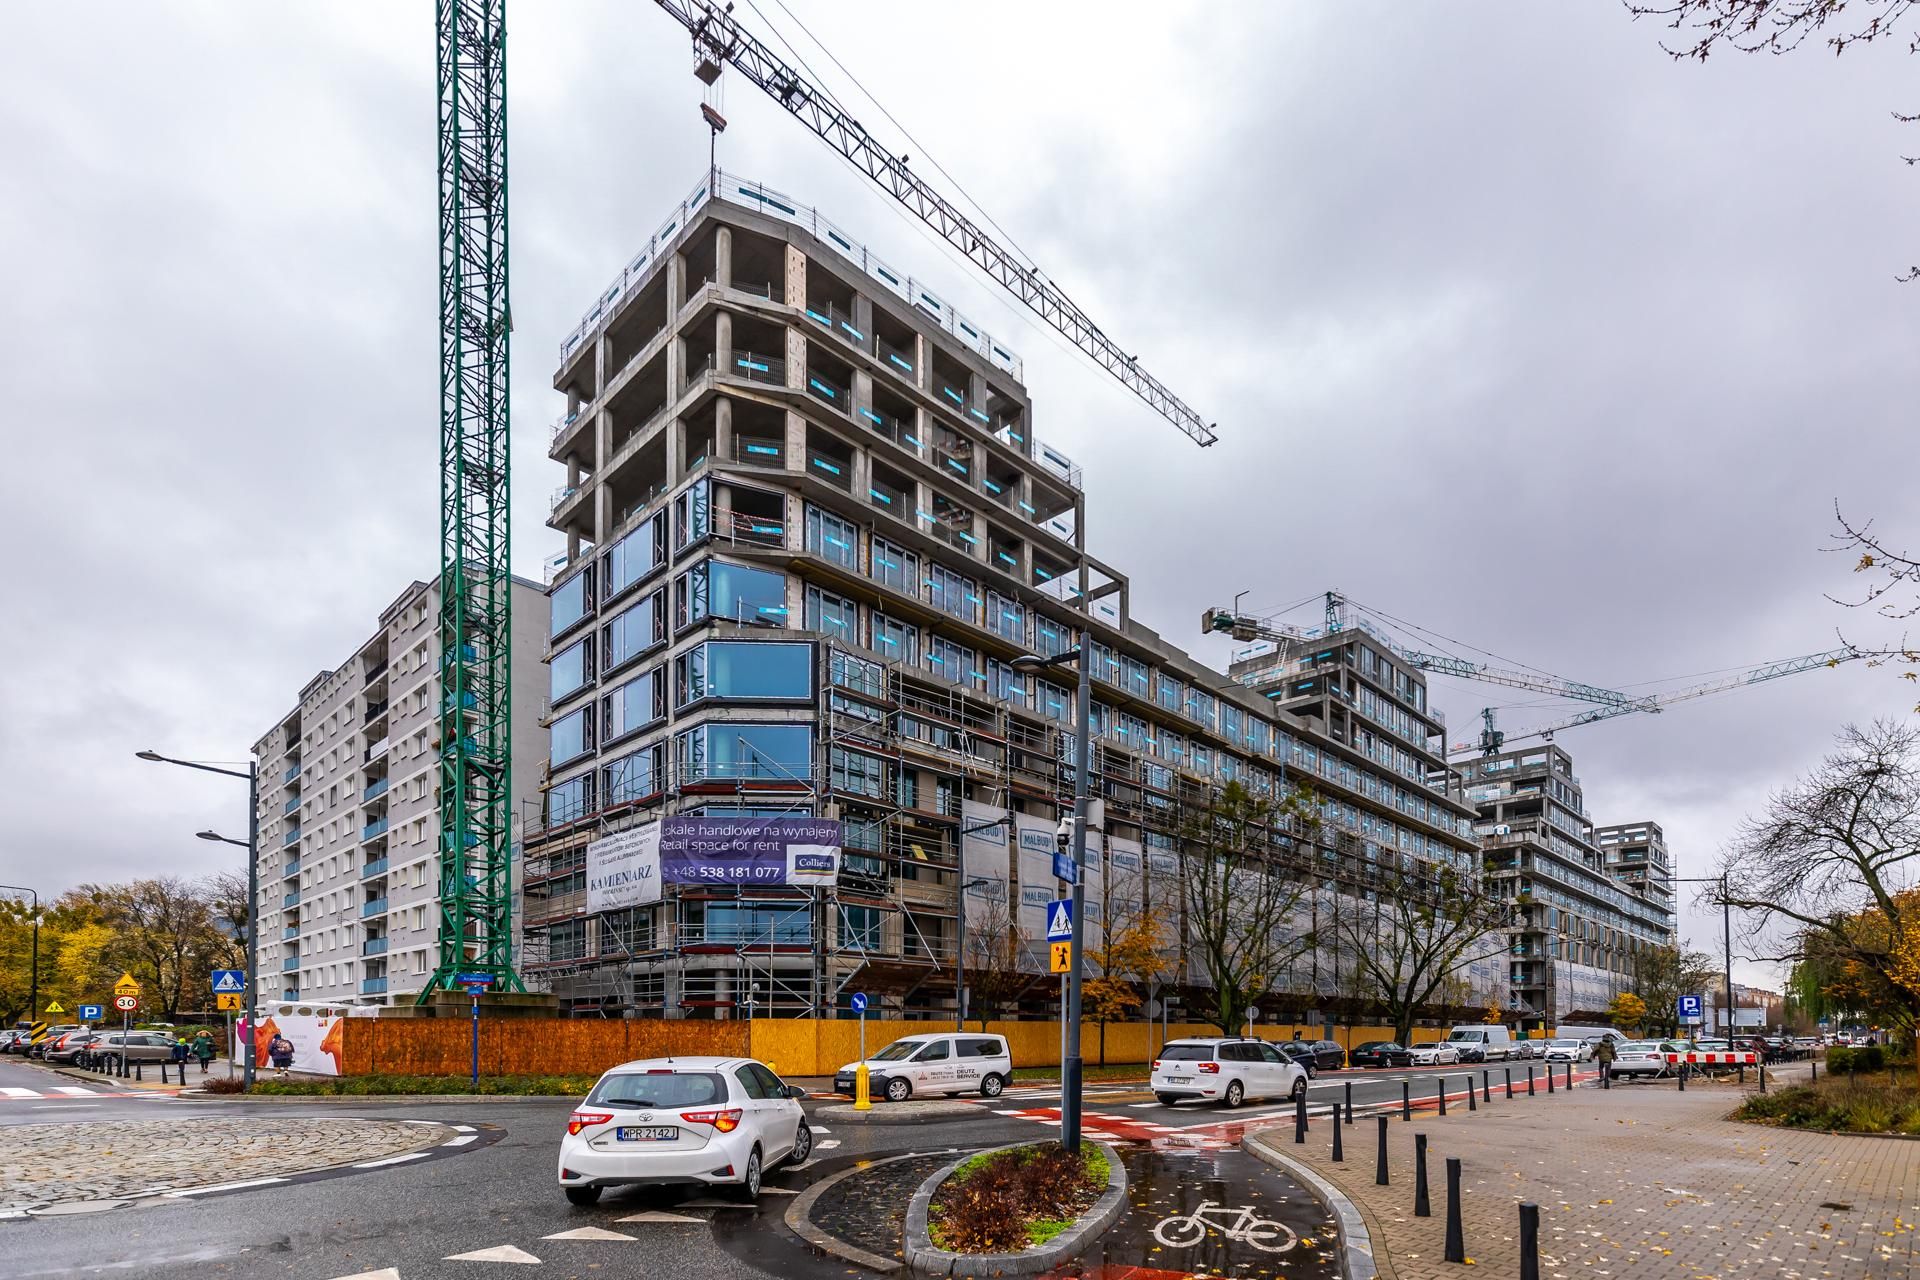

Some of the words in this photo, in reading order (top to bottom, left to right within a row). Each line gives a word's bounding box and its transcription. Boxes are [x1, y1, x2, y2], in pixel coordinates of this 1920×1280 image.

[699, 824, 760, 837] handlowe
[764, 826, 780, 837] na
[783, 826, 838, 840] wynajem
[661, 839, 688, 851] Retail
[691, 841, 730, 853] space
[732, 839, 751, 851] for
[753, 841, 780, 851] rent
[799, 858, 831, 868] Colliers
[672, 866, 696, 877] +48
[700, 867, 725, 878] 538
[729, 867, 751, 878] 181
[756, 867, 780, 878] 077
[590, 865, 652, 892] KAMIENIARZ
[118, 999, 135, 1007] 30
[1683, 997, 1697, 1011] P
[84, 1006, 98, 1018] P
[623, 1128, 643, 1138] WPR
[645, 1128, 676, 1138] 2142J
